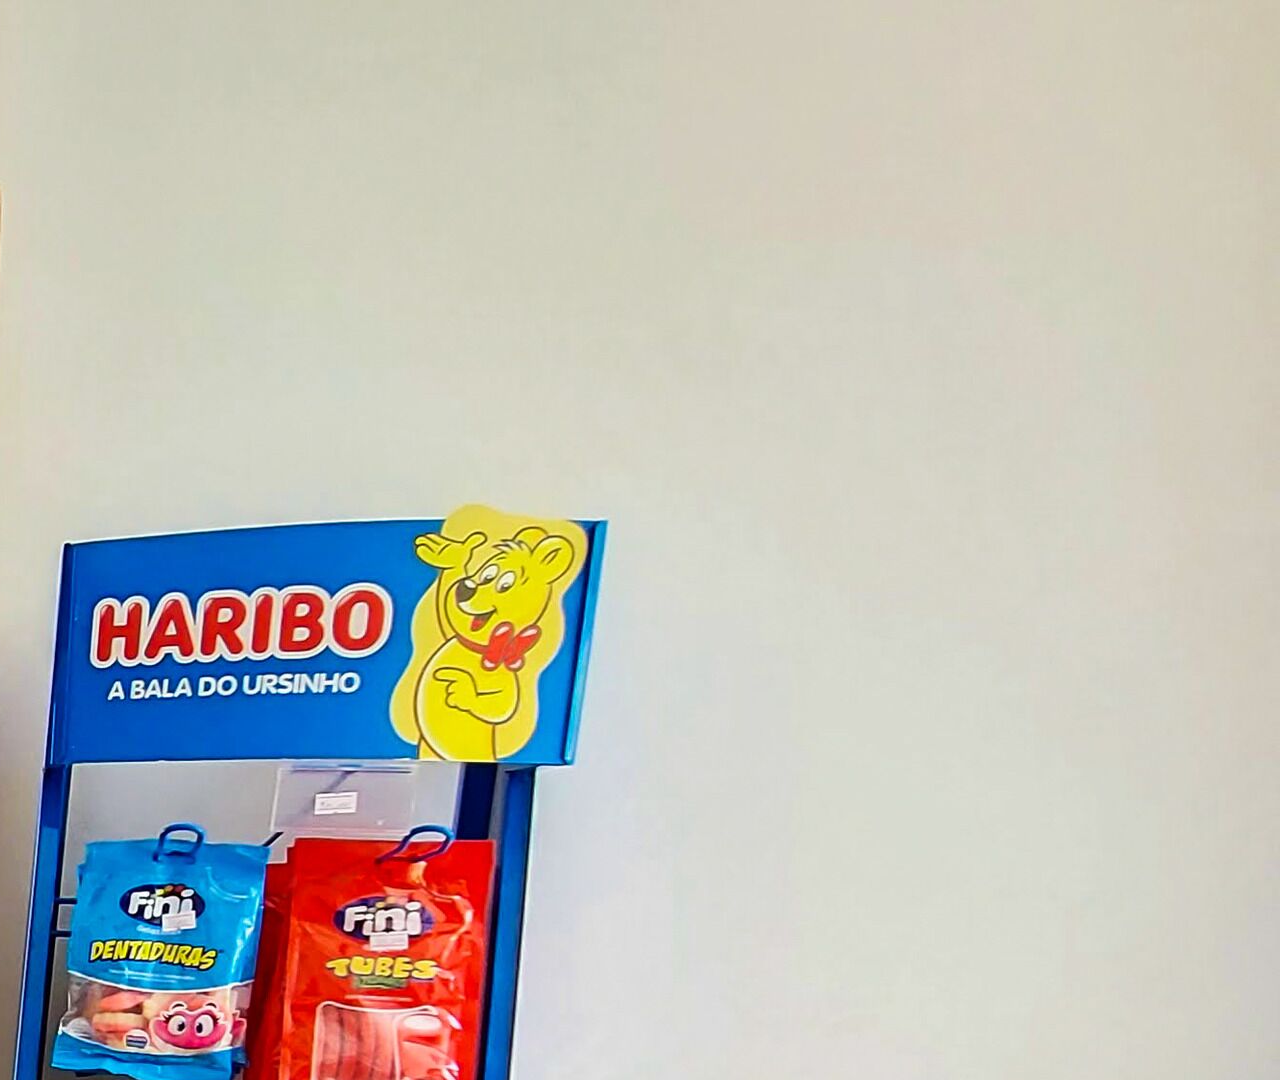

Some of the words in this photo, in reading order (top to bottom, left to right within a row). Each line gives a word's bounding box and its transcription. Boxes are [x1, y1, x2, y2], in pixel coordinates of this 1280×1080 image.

[92, 585, 391, 667] HARIBO
[108, 681, 125, 701] A
[129, 676, 193, 700] BALA
[198, 674, 237, 697] DO
[243, 671, 361, 696] URSINHO
[128, 887, 195, 923] Fini
[343, 898, 422, 936] Fini
[90, 939, 218, 969] DENTADURAS
[326, 955, 439, 980] TUBES
